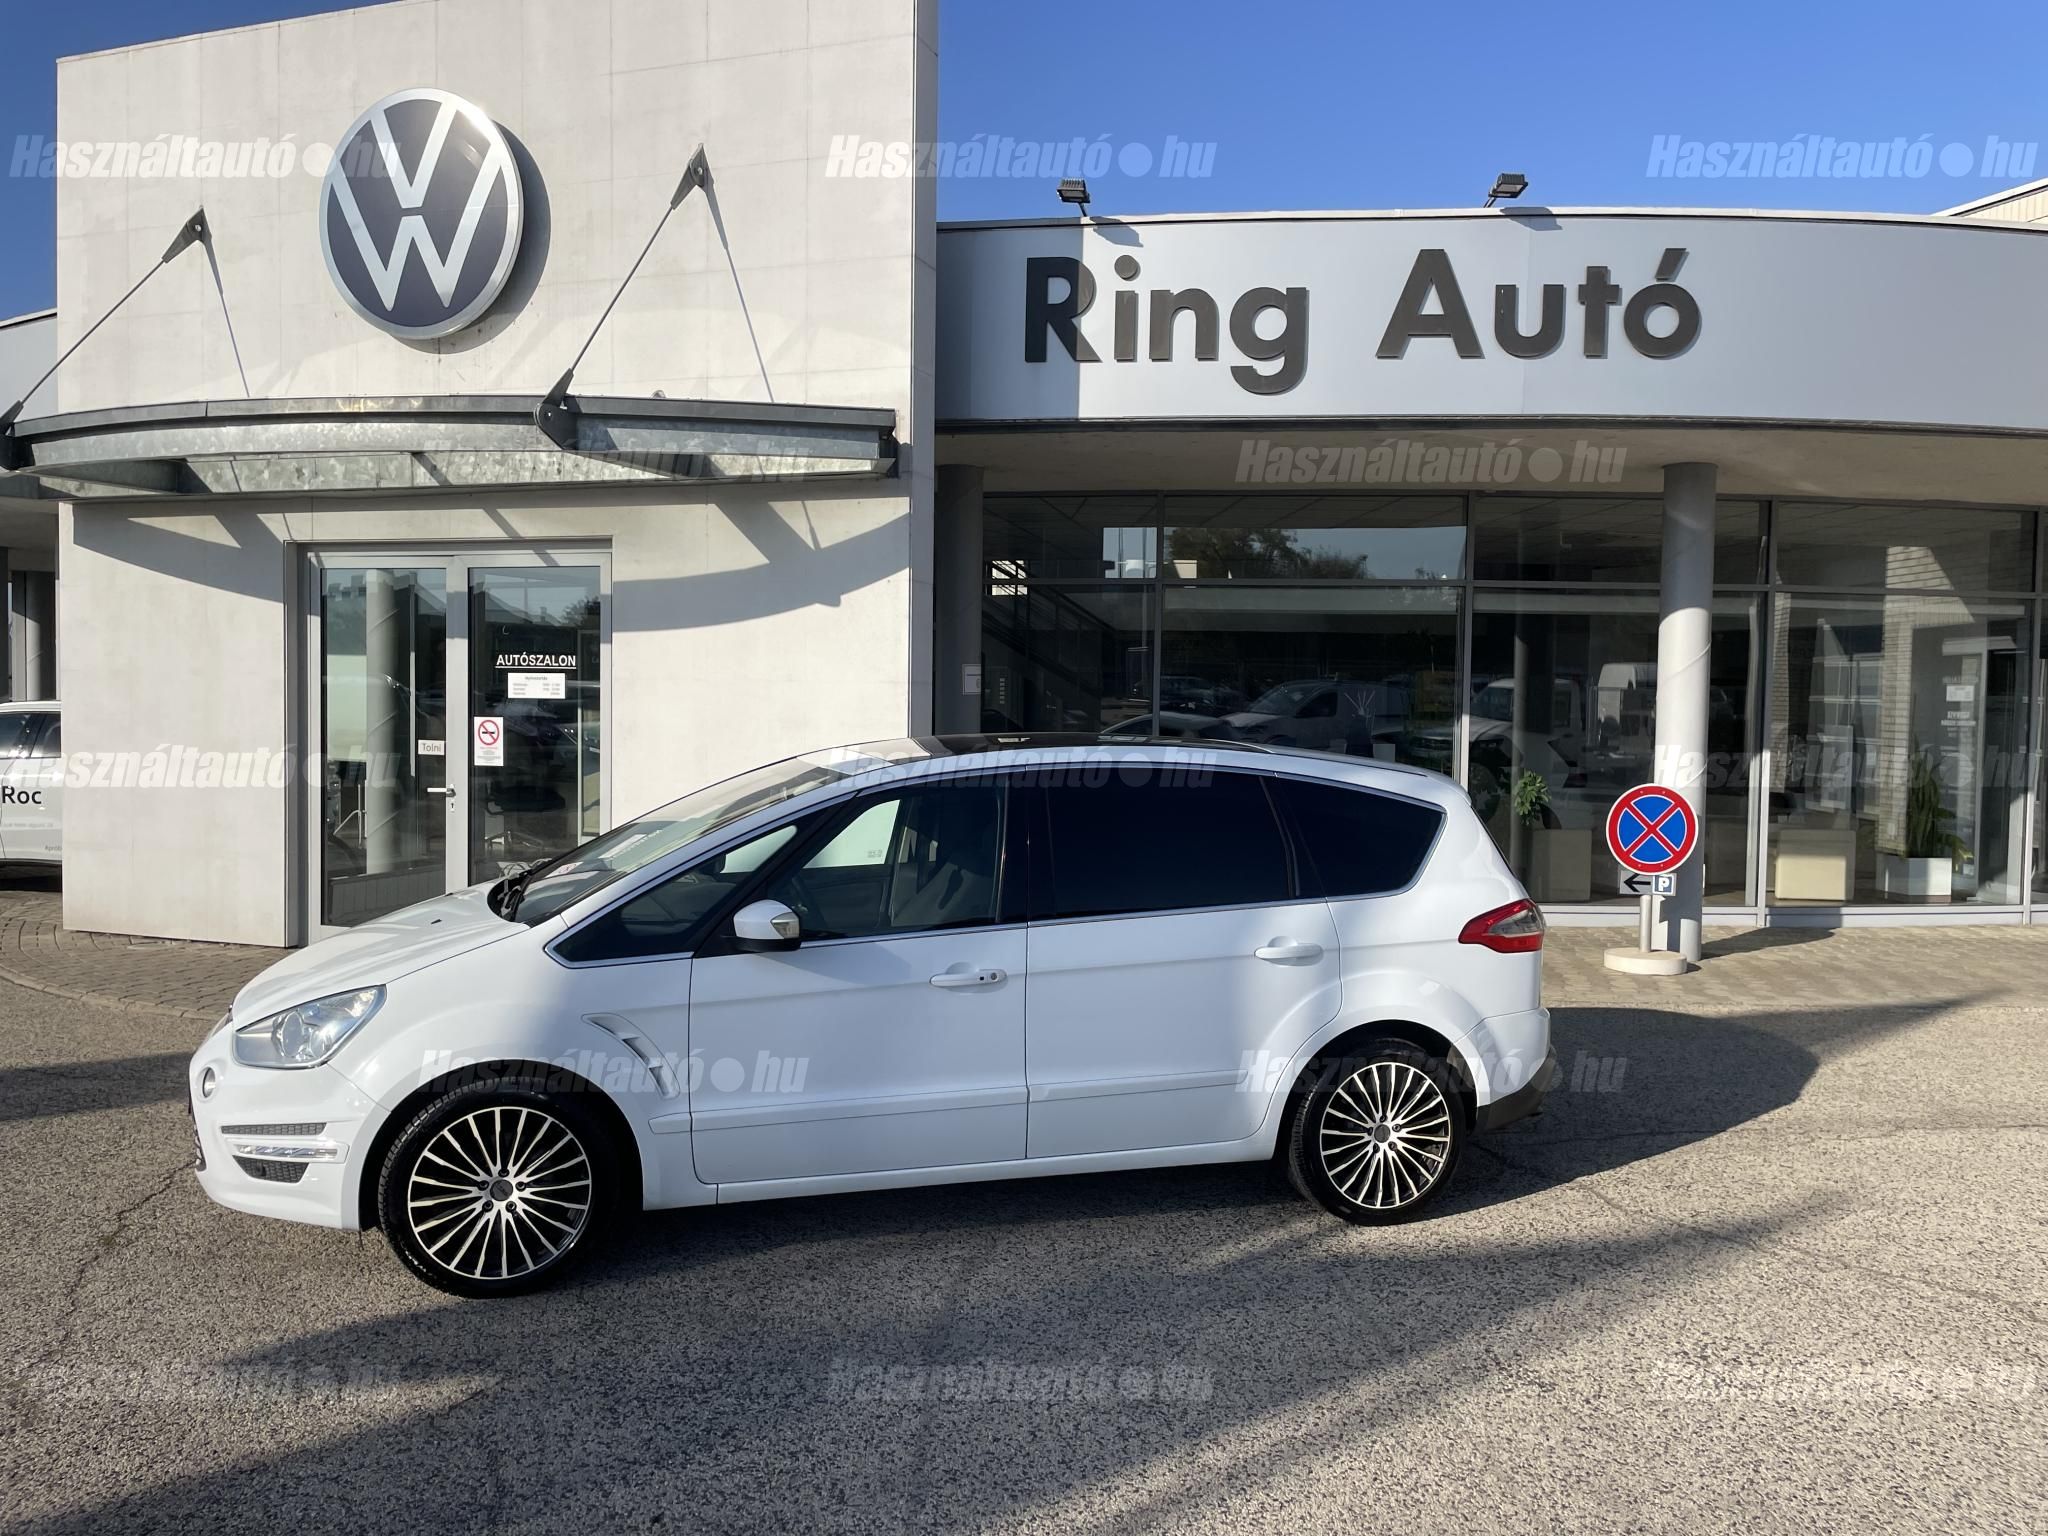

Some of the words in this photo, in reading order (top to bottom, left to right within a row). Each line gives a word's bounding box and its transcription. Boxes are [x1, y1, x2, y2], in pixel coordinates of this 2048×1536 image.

[1024, 254, 1309, 396] Ring
[1375, 247, 1702, 360] Autó
[496, 651, 577, 667] AUTÓSZALON
[421, 742, 442, 753] Tolni
[1, 785, 42, 805] Roc
[1658, 877, 1670, 892] P
